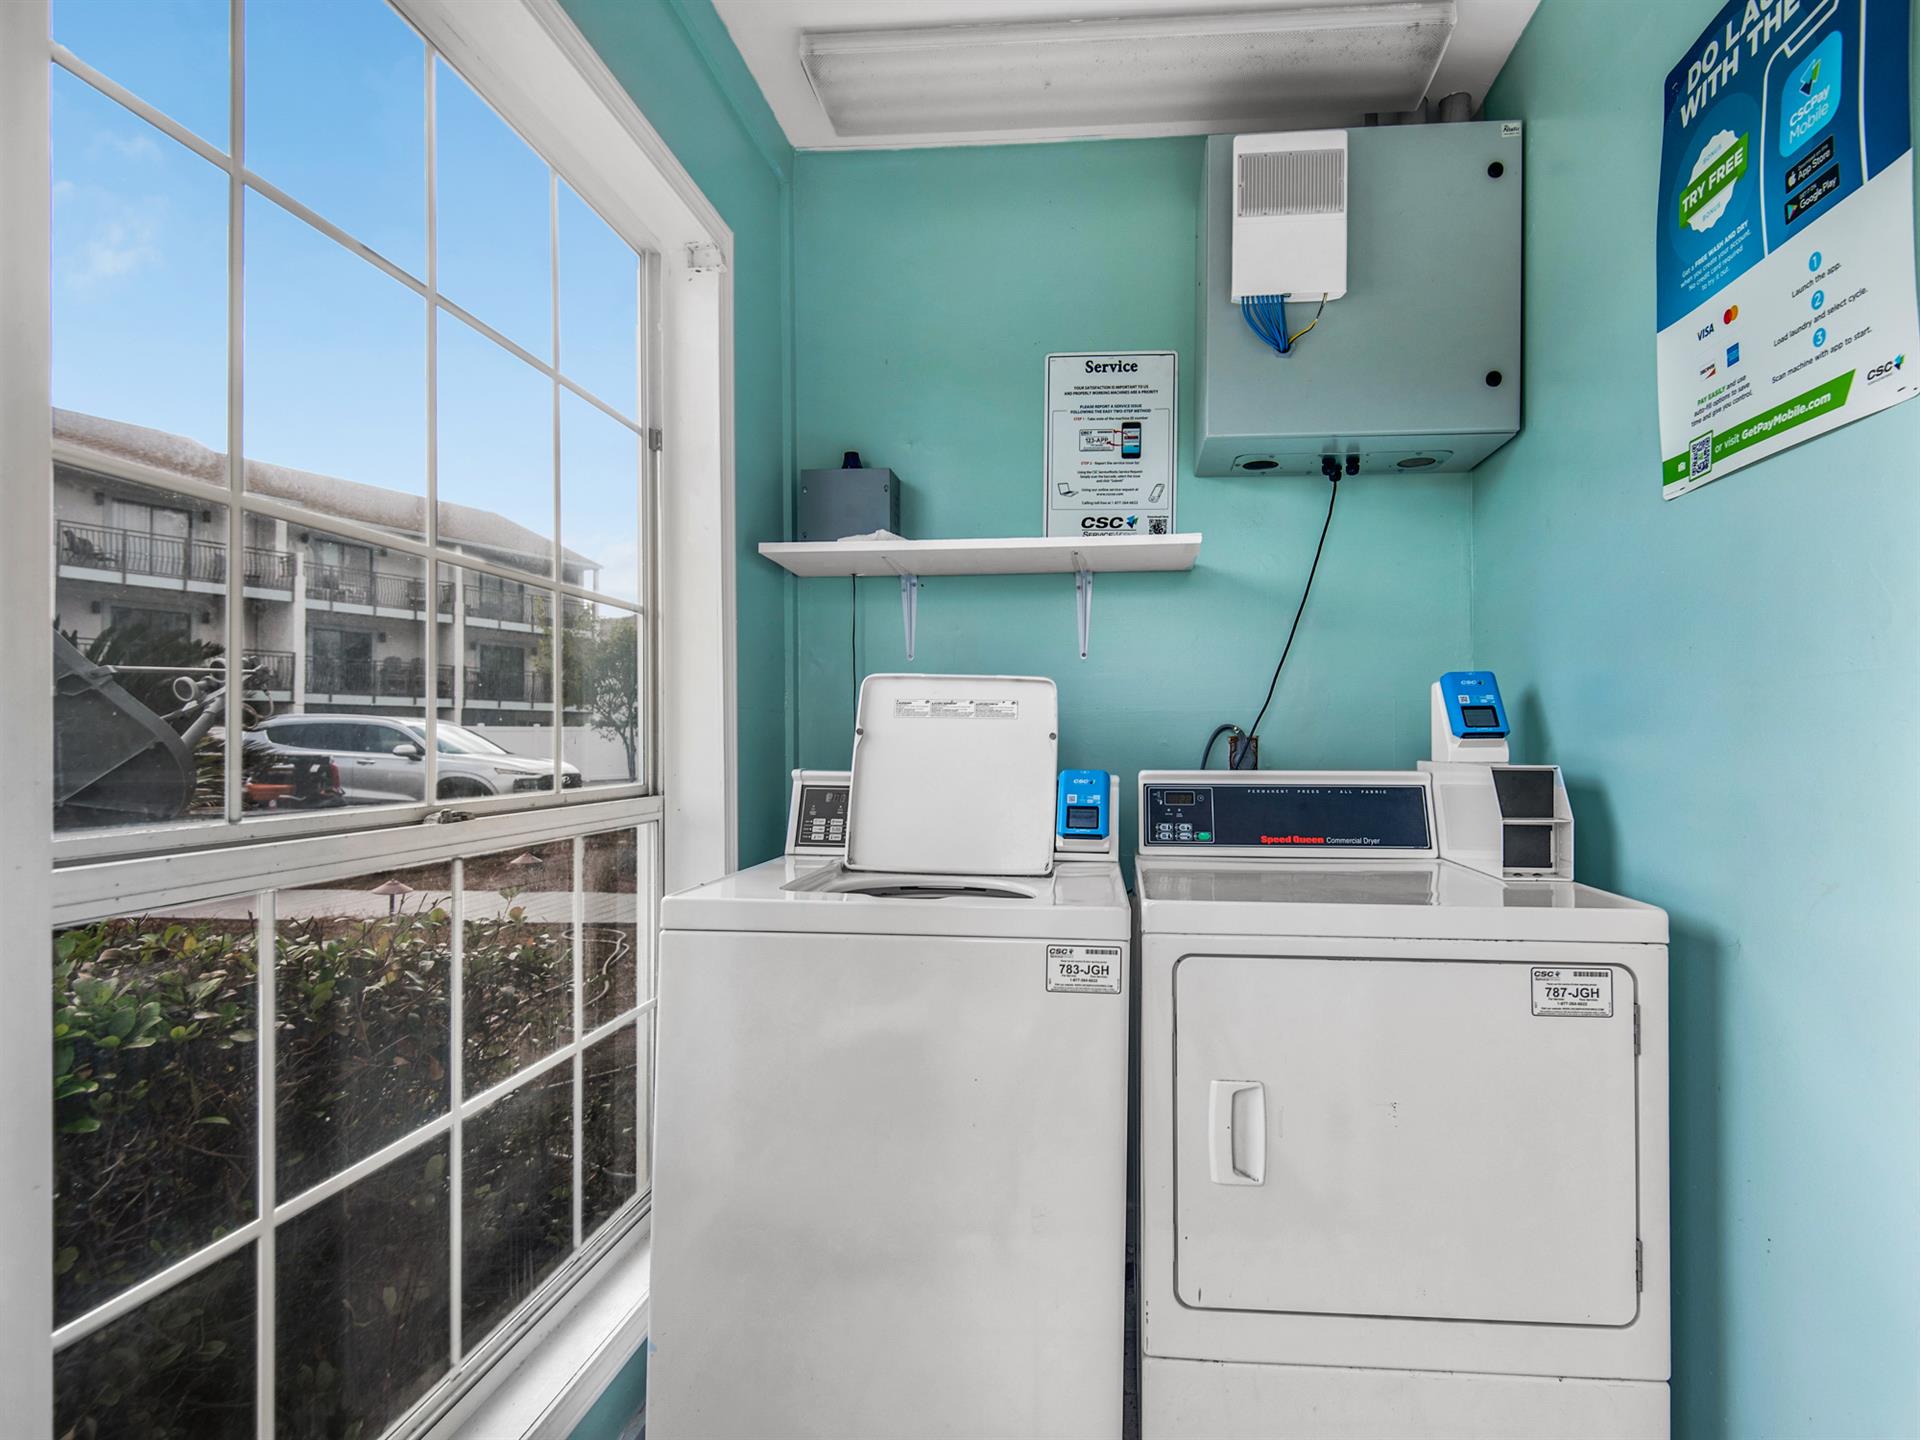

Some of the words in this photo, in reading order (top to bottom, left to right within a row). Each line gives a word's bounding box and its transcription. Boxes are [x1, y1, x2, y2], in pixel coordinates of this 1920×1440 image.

[1680, 45, 1739, 129] WITH
[1746, 0, 1801, 57] THE
[1687, 40, 1719, 95] DO
[1790, 84, 1830, 127] CSCPay
[1790, 103, 1829, 144] Mobile
[1682, 181, 1706, 213] TRY
[1708, 147, 1743, 191] FREE
[1798, 165, 1812, 180] App
[1812, 149, 1831, 169] Store
[1800, 188, 1822, 209] Google
[1822, 177, 1837, 192] Play
[1695, 253, 1708, 268] FREE
[1708, 239, 1724, 257] WASH
[1724, 230, 1737, 244] AND
[1737, 219, 1749, 233] DRY
[1812, 256, 1818, 268] 1
[1792, 279, 1814, 298] Launch
[1815, 272, 1826, 283] the
[1827, 262, 1842, 275] app.
[1814, 293, 1823, 309] 2
[1697, 323, 1714, 341] VISA
[1773, 332, 1788, 347] Load
[1789, 319, 1812, 338] laundry
[1813, 310, 1826, 324] and
[1827, 298, 1847, 315] select
[1848, 287, 1868, 302] cycle.
[1815, 330, 1824, 345] 3
[1085, 359, 1138, 374] Service
[1772, 372, 1787, 384] Scan
[1787, 358, 1814, 376] machine
[1814, 349, 1829, 361] with
[1830, 342, 1844, 354] app
[1844, 336, 1853, 346] to
[1853, 326, 1872, 341] start.
[1867, 360, 1893, 380] CSC
[1697, 396, 1707, 406] PAY
[1708, 385, 1726, 401] EASILY
[1726, 380, 1736, 390] and
[1737, 375, 1747, 383] use
[1712, 393, 1731, 407] options
[1738, 382, 1750, 393] save
[1691, 419, 1702, 427] time
[1702, 412, 1711, 422] and
[1712, 406, 1722, 417] give
[1723, 401, 1732, 411] you
[1714, 443, 1723, 453] or
[1724, 433, 1740, 448] visit
[1741, 392, 1832, 440] GetPayMobile.com
[1081, 516, 1124, 529] CSC
[1261, 834, 1291, 844] Speed
[1293, 835, 1324, 843] Queen
[1363, 837, 1380, 845] Dryer
[1059, 963, 1109, 975] 783-JGH
[1544, 987, 1600, 998] 787-JGH
